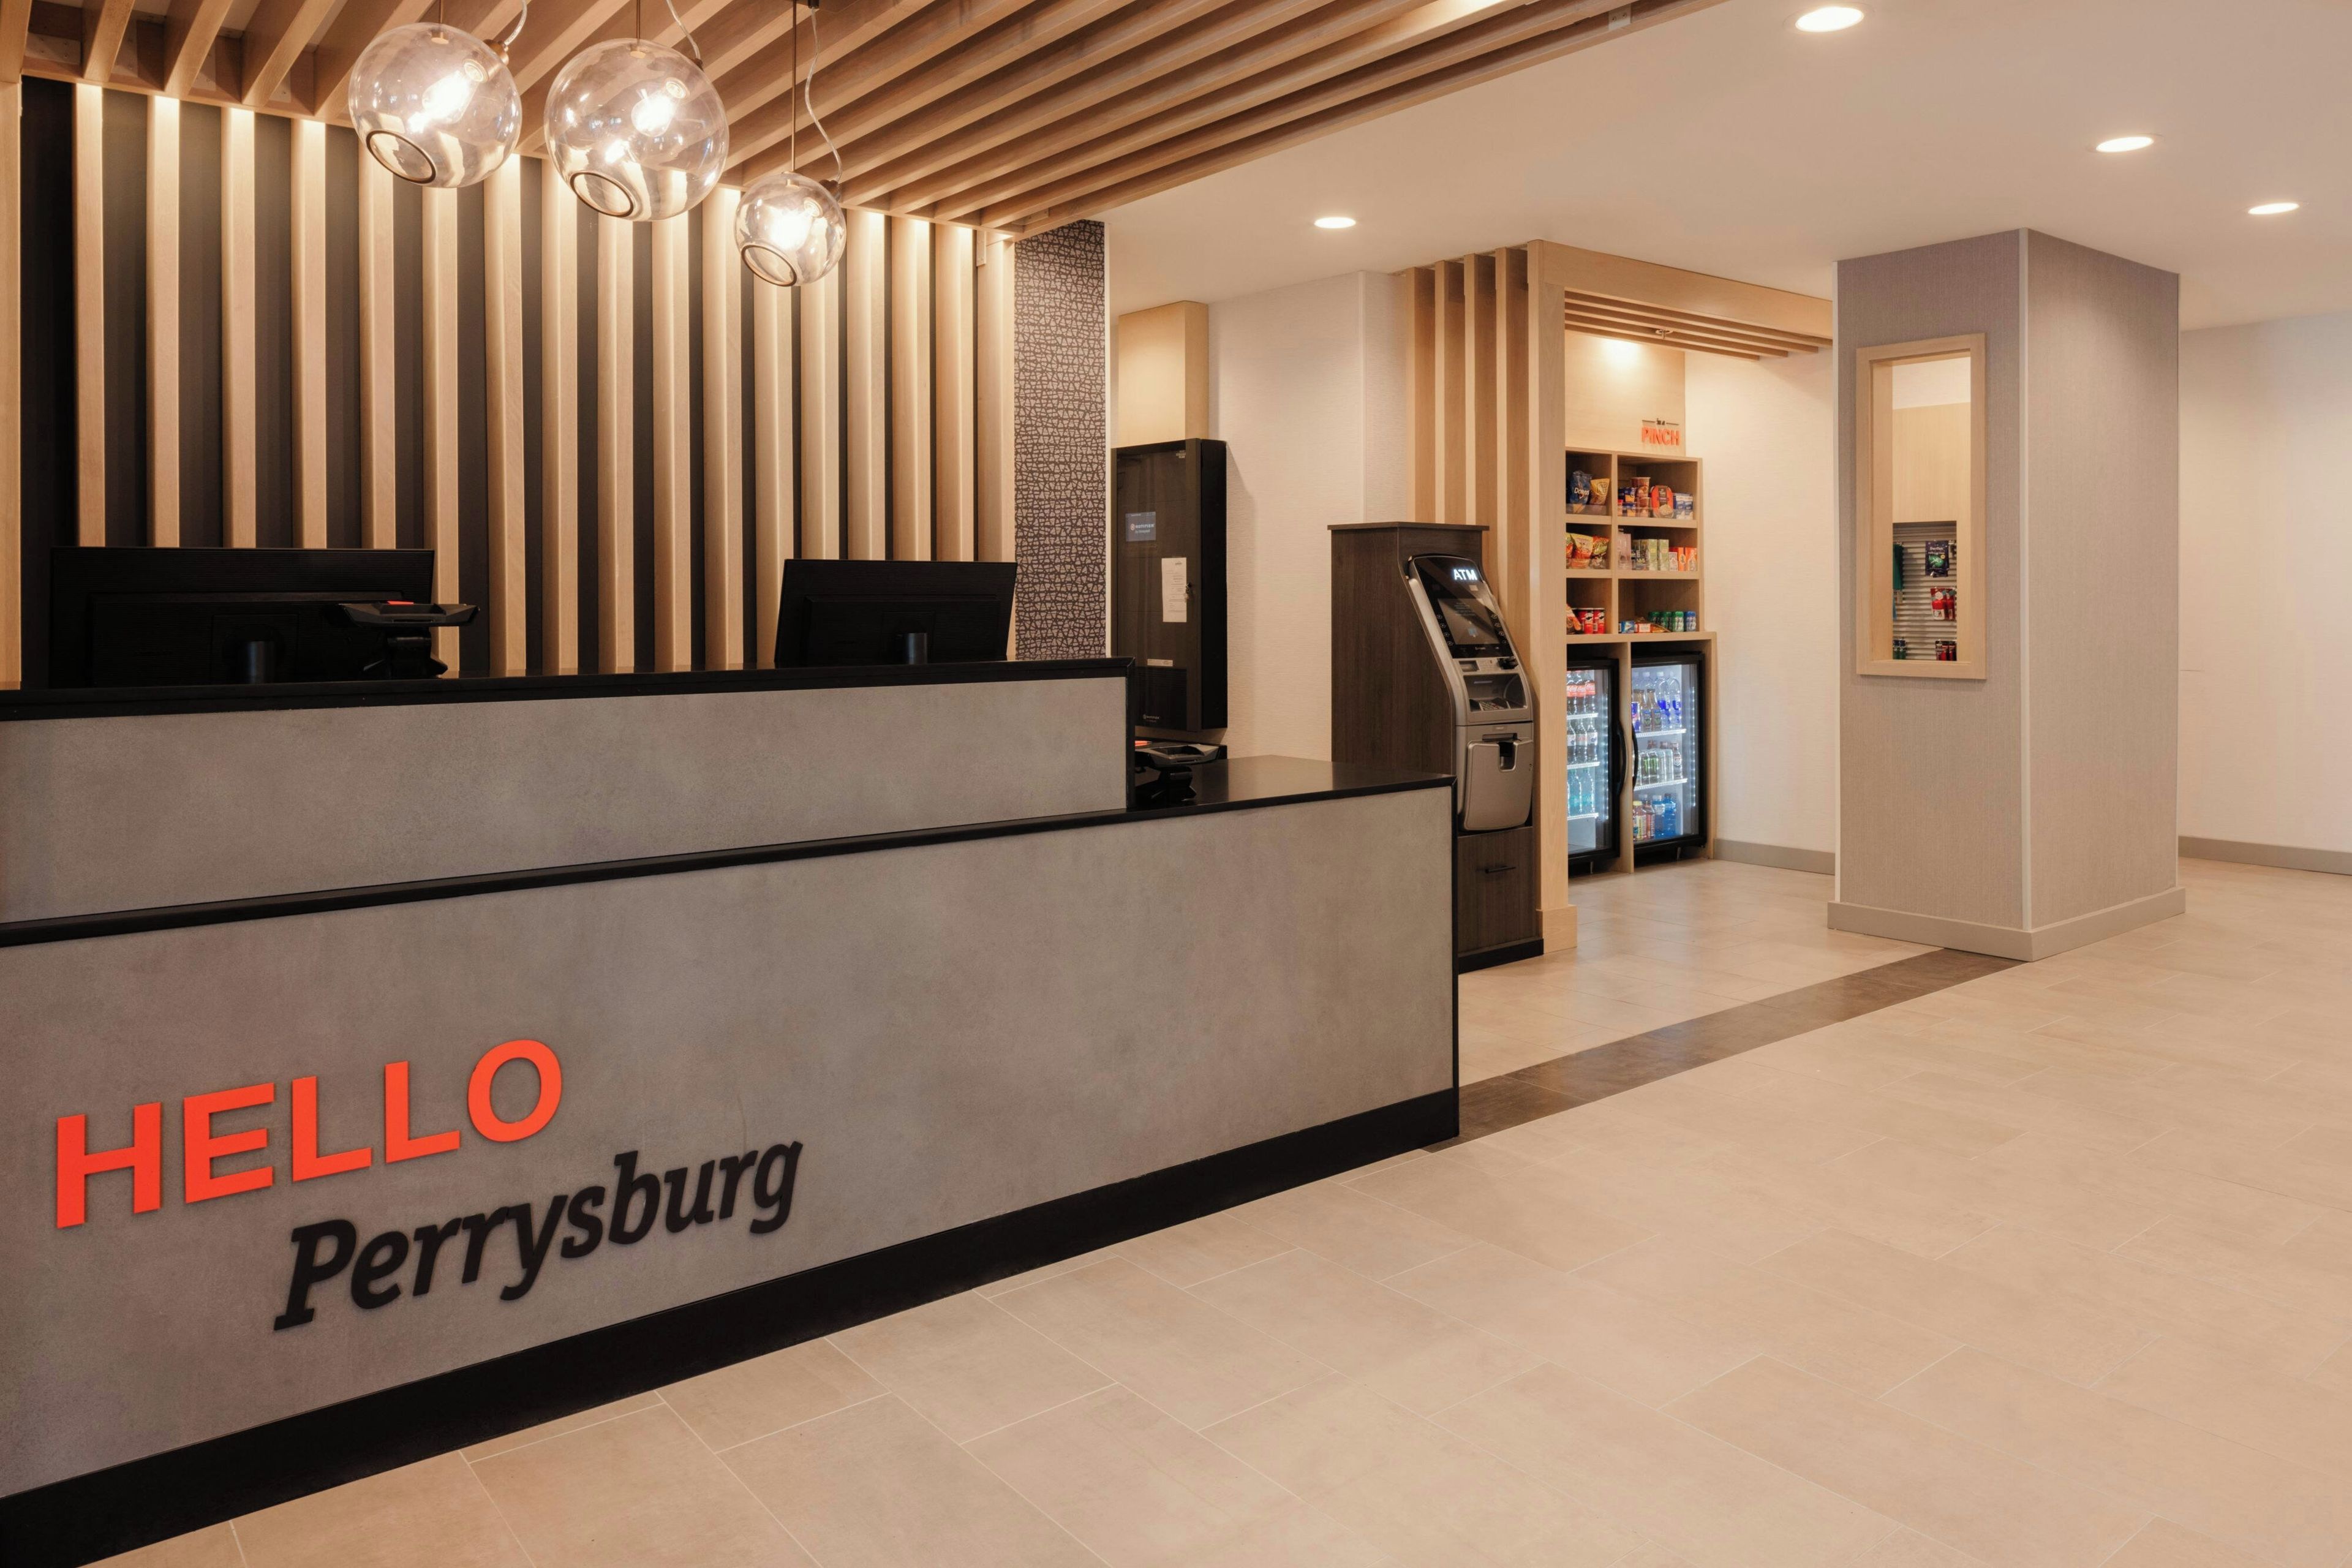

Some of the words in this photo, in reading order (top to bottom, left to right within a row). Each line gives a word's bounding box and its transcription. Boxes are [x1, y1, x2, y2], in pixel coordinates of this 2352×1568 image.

[1642, 427, 1680, 446] PINCH
[1453, 569, 1477, 581] ATM
[56, 1039, 562, 1229] HELLO
[273, 1141, 803, 1331] Perrysburg
